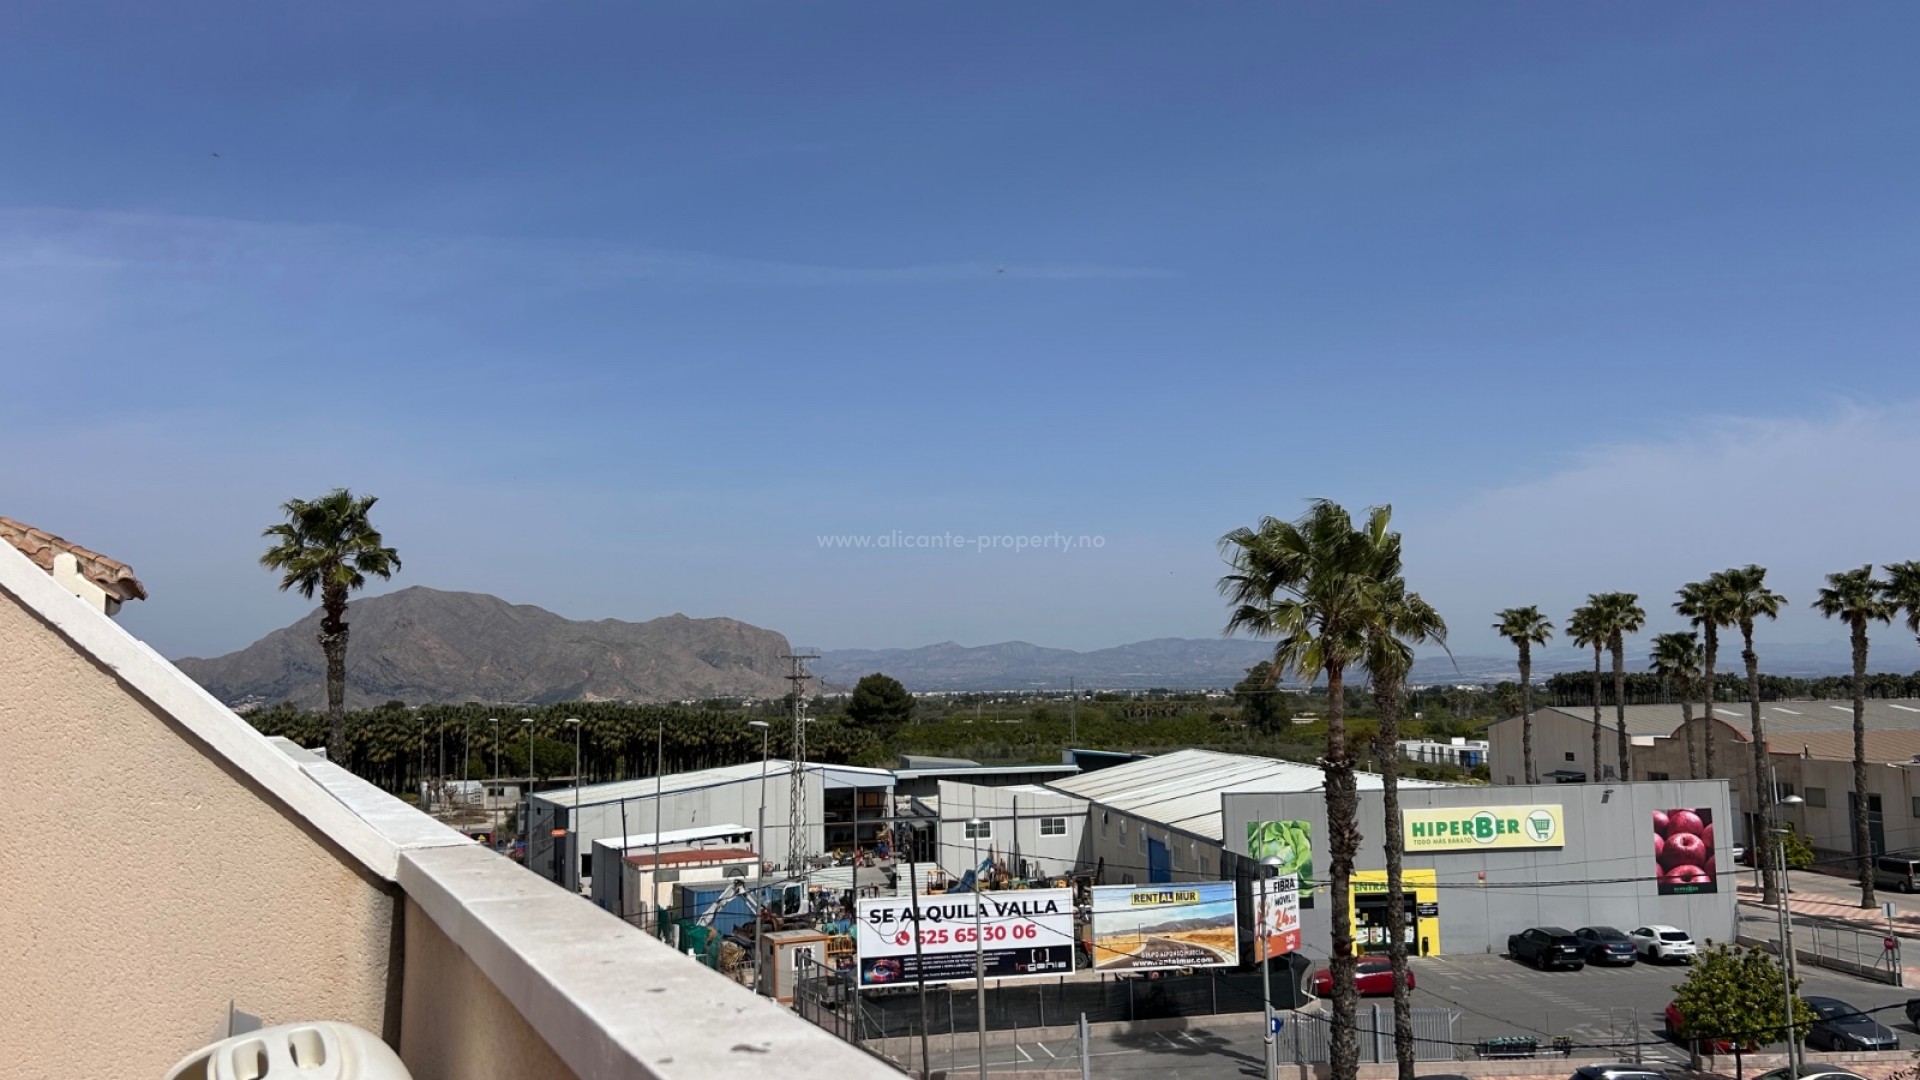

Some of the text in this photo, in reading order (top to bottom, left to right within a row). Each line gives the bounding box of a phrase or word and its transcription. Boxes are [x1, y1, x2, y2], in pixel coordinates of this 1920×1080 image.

[1411, 816, 1520, 839] HIPERBER
[1273, 878, 1296, 893] FIBRA
[1133, 891, 1196, 903] RENT AL MUR
[869, 899, 1059, 924] SE ALQUILA VALLA
[983, 925, 1007, 942] 30
[1012, 923, 1038, 940] 06
